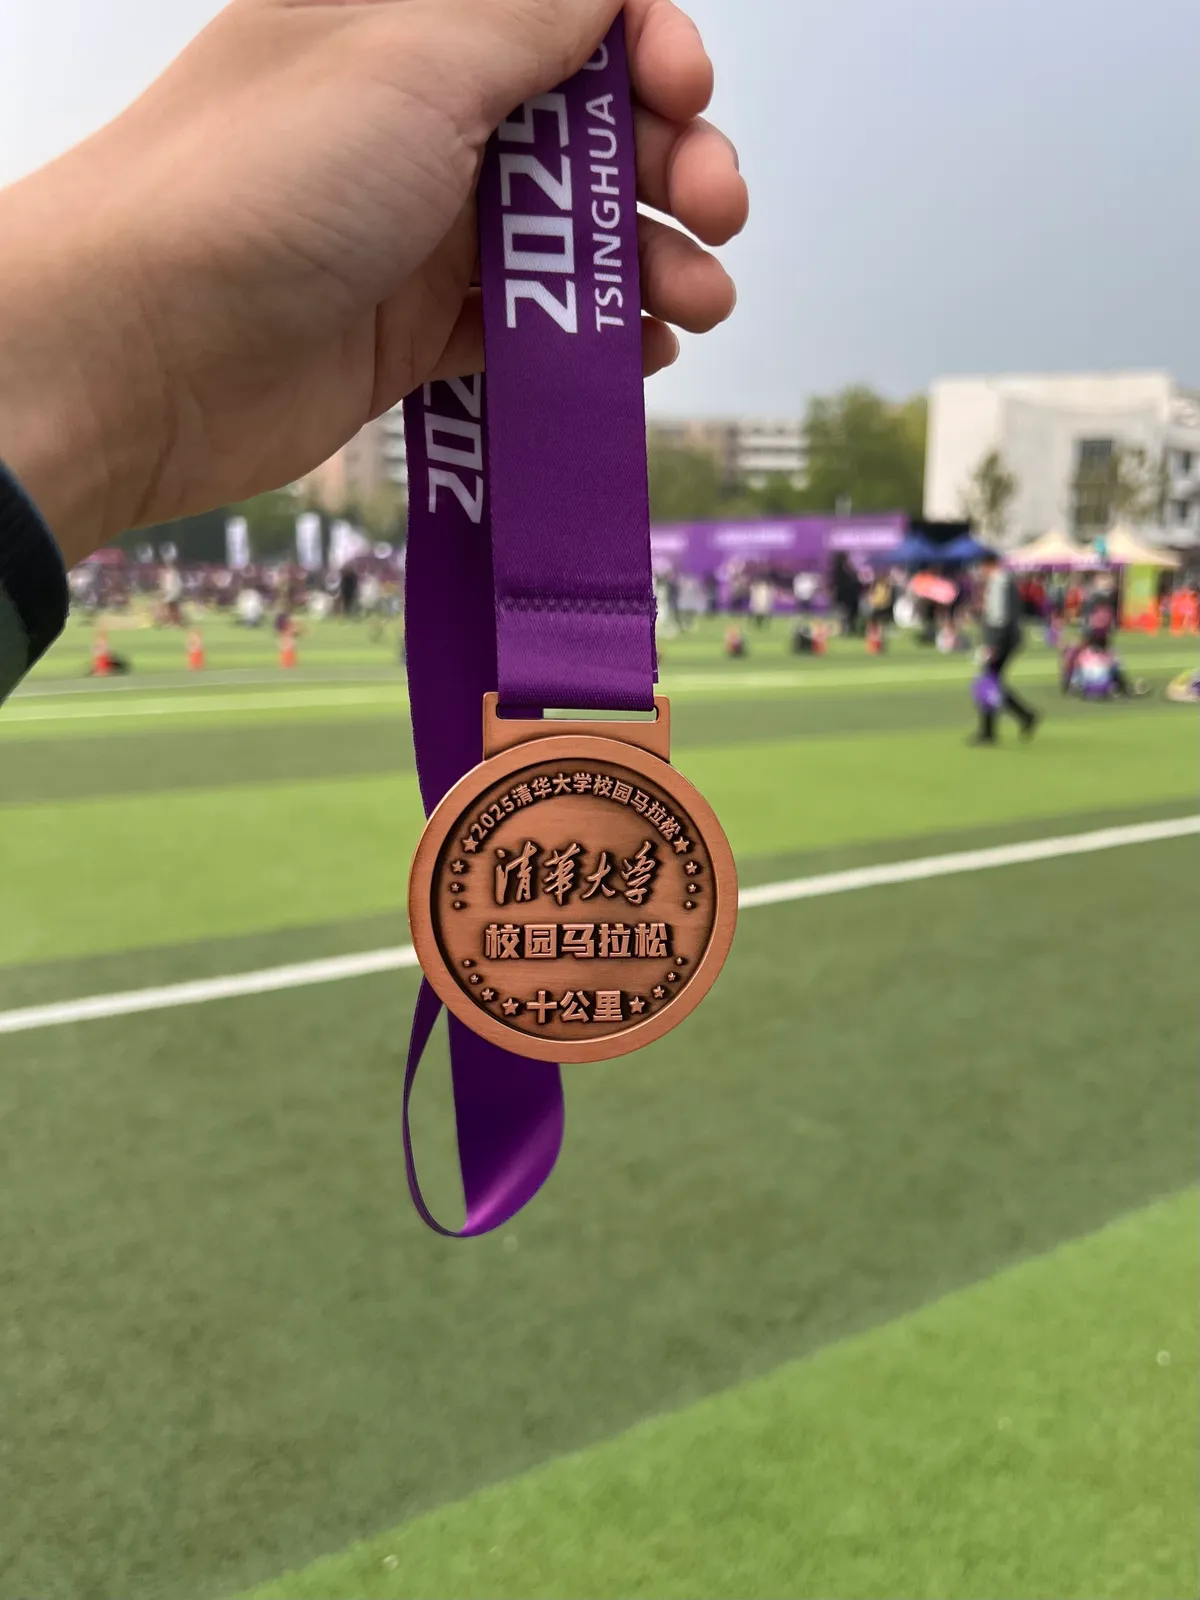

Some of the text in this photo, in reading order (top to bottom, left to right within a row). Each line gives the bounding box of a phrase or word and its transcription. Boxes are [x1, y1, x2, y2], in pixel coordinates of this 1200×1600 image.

[498, 92, 578, 335] 2025
[585, 93, 625, 333] TSINGHUA
[474, 773, 681, 841] 2025清华大学校园马拉松
[485, 923, 668, 959] 校园马拉松
[526, 990, 623, 1023] 十公里
